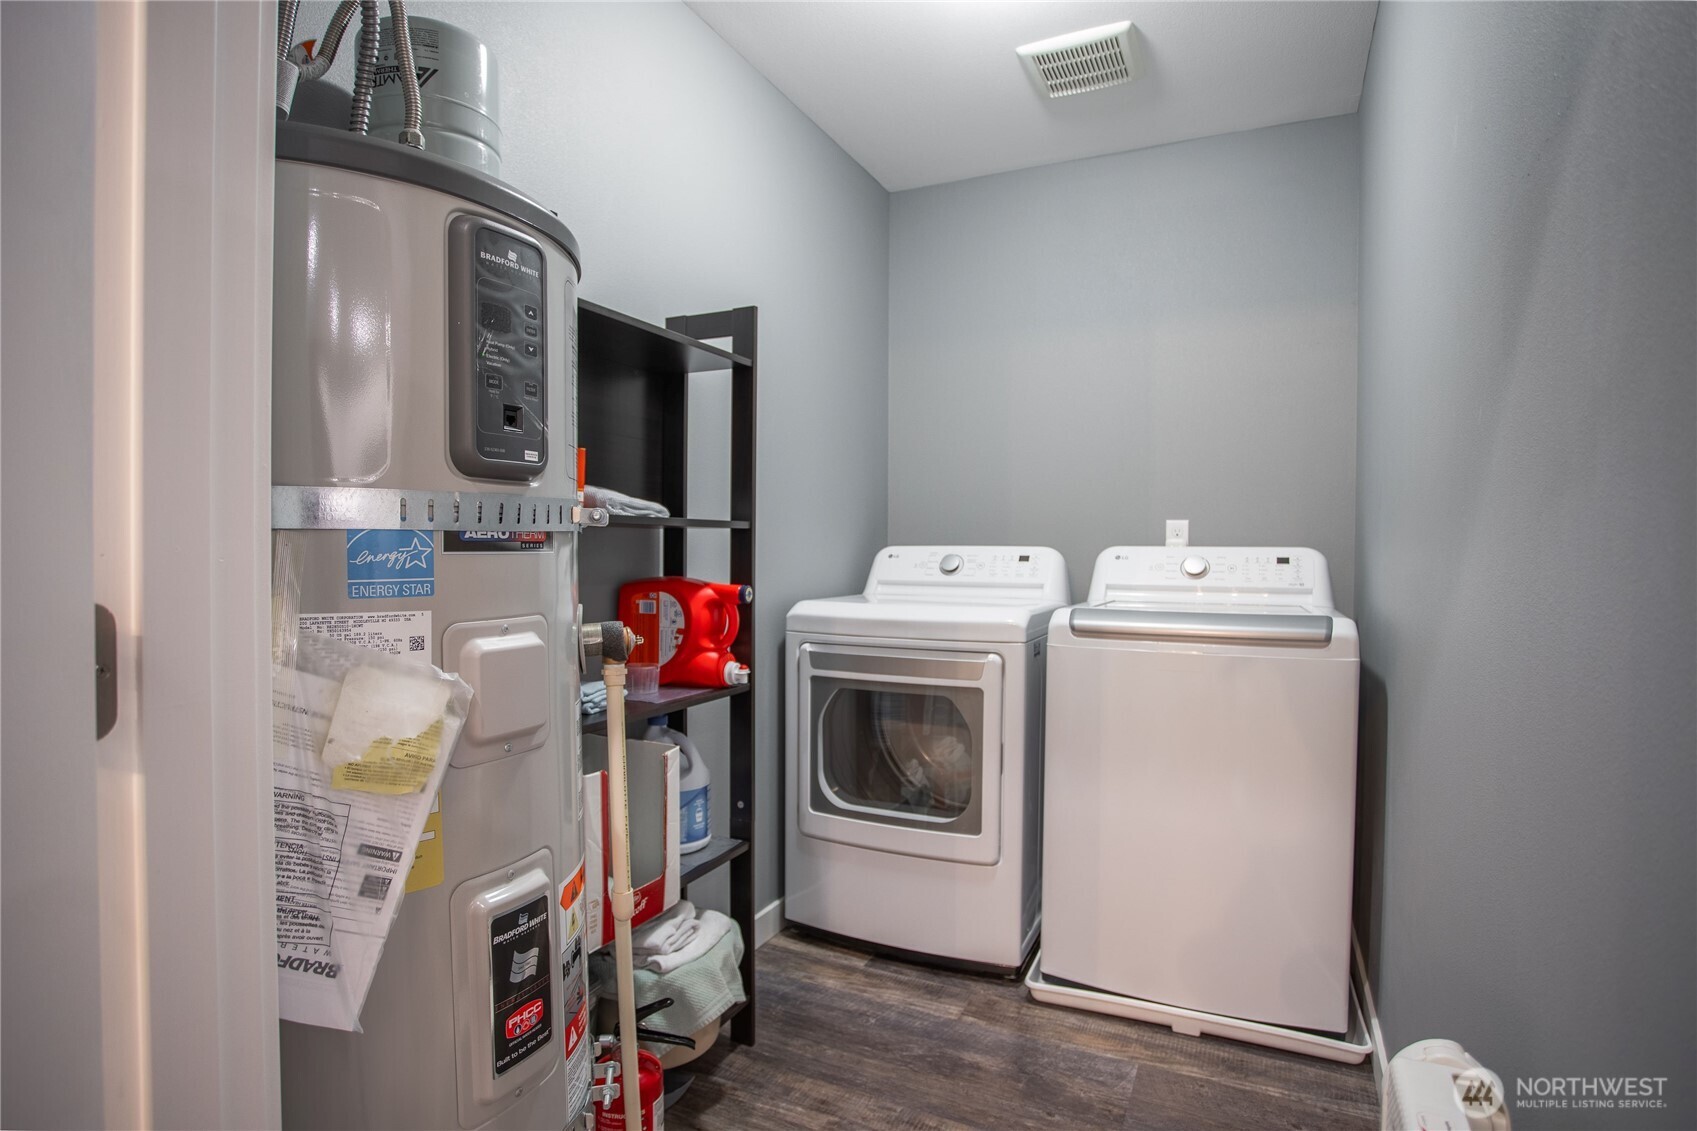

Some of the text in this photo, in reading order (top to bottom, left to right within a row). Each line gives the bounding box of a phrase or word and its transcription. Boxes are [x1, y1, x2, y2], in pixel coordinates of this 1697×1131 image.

[480, 251, 519, 269] BRADFORD
[520, 264, 539, 278] WHITE
[350, 550, 417, 570] energy
[352, 583, 431, 597] ENERGY STAR
[493, 911, 547, 946] BRADFORD WHITE
[508, 1002, 542, 1029] PHCC
[496, 1054, 511, 1068] Built
[511, 1051, 518, 1060] to
[518, 1046, 527, 1055] be
[527, 1039, 537, 1048] the
